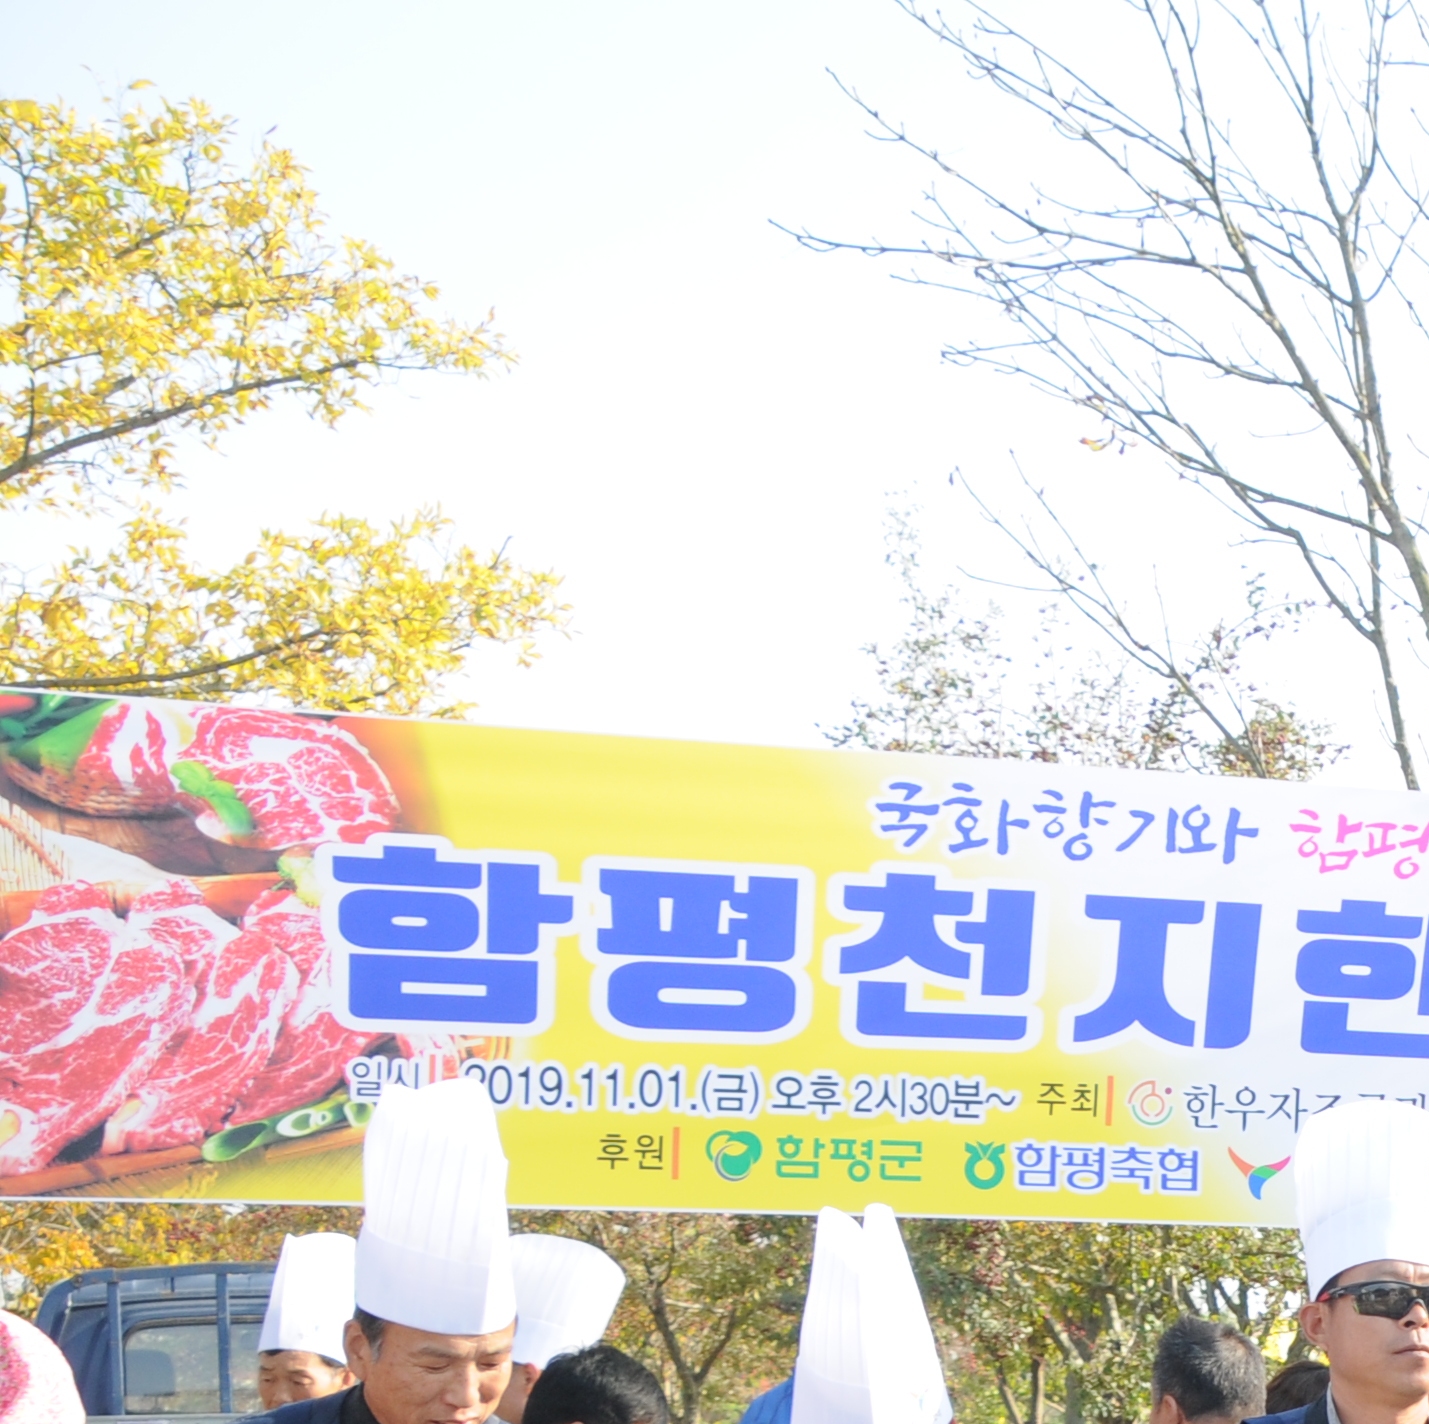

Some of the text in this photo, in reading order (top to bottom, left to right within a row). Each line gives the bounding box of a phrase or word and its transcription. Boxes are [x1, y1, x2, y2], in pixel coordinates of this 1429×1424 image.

[875, 781, 1260, 865] 국화향기와
[771, 1074, 842, 1115] 오후
[853, 1078, 1016, 1119] 2시30분~
[1036, 1082, 1099, 1117] 주최
[596, 1133, 923, 1183] 후원 함평군
[1015, 1143, 1199, 1192] 함평축협
